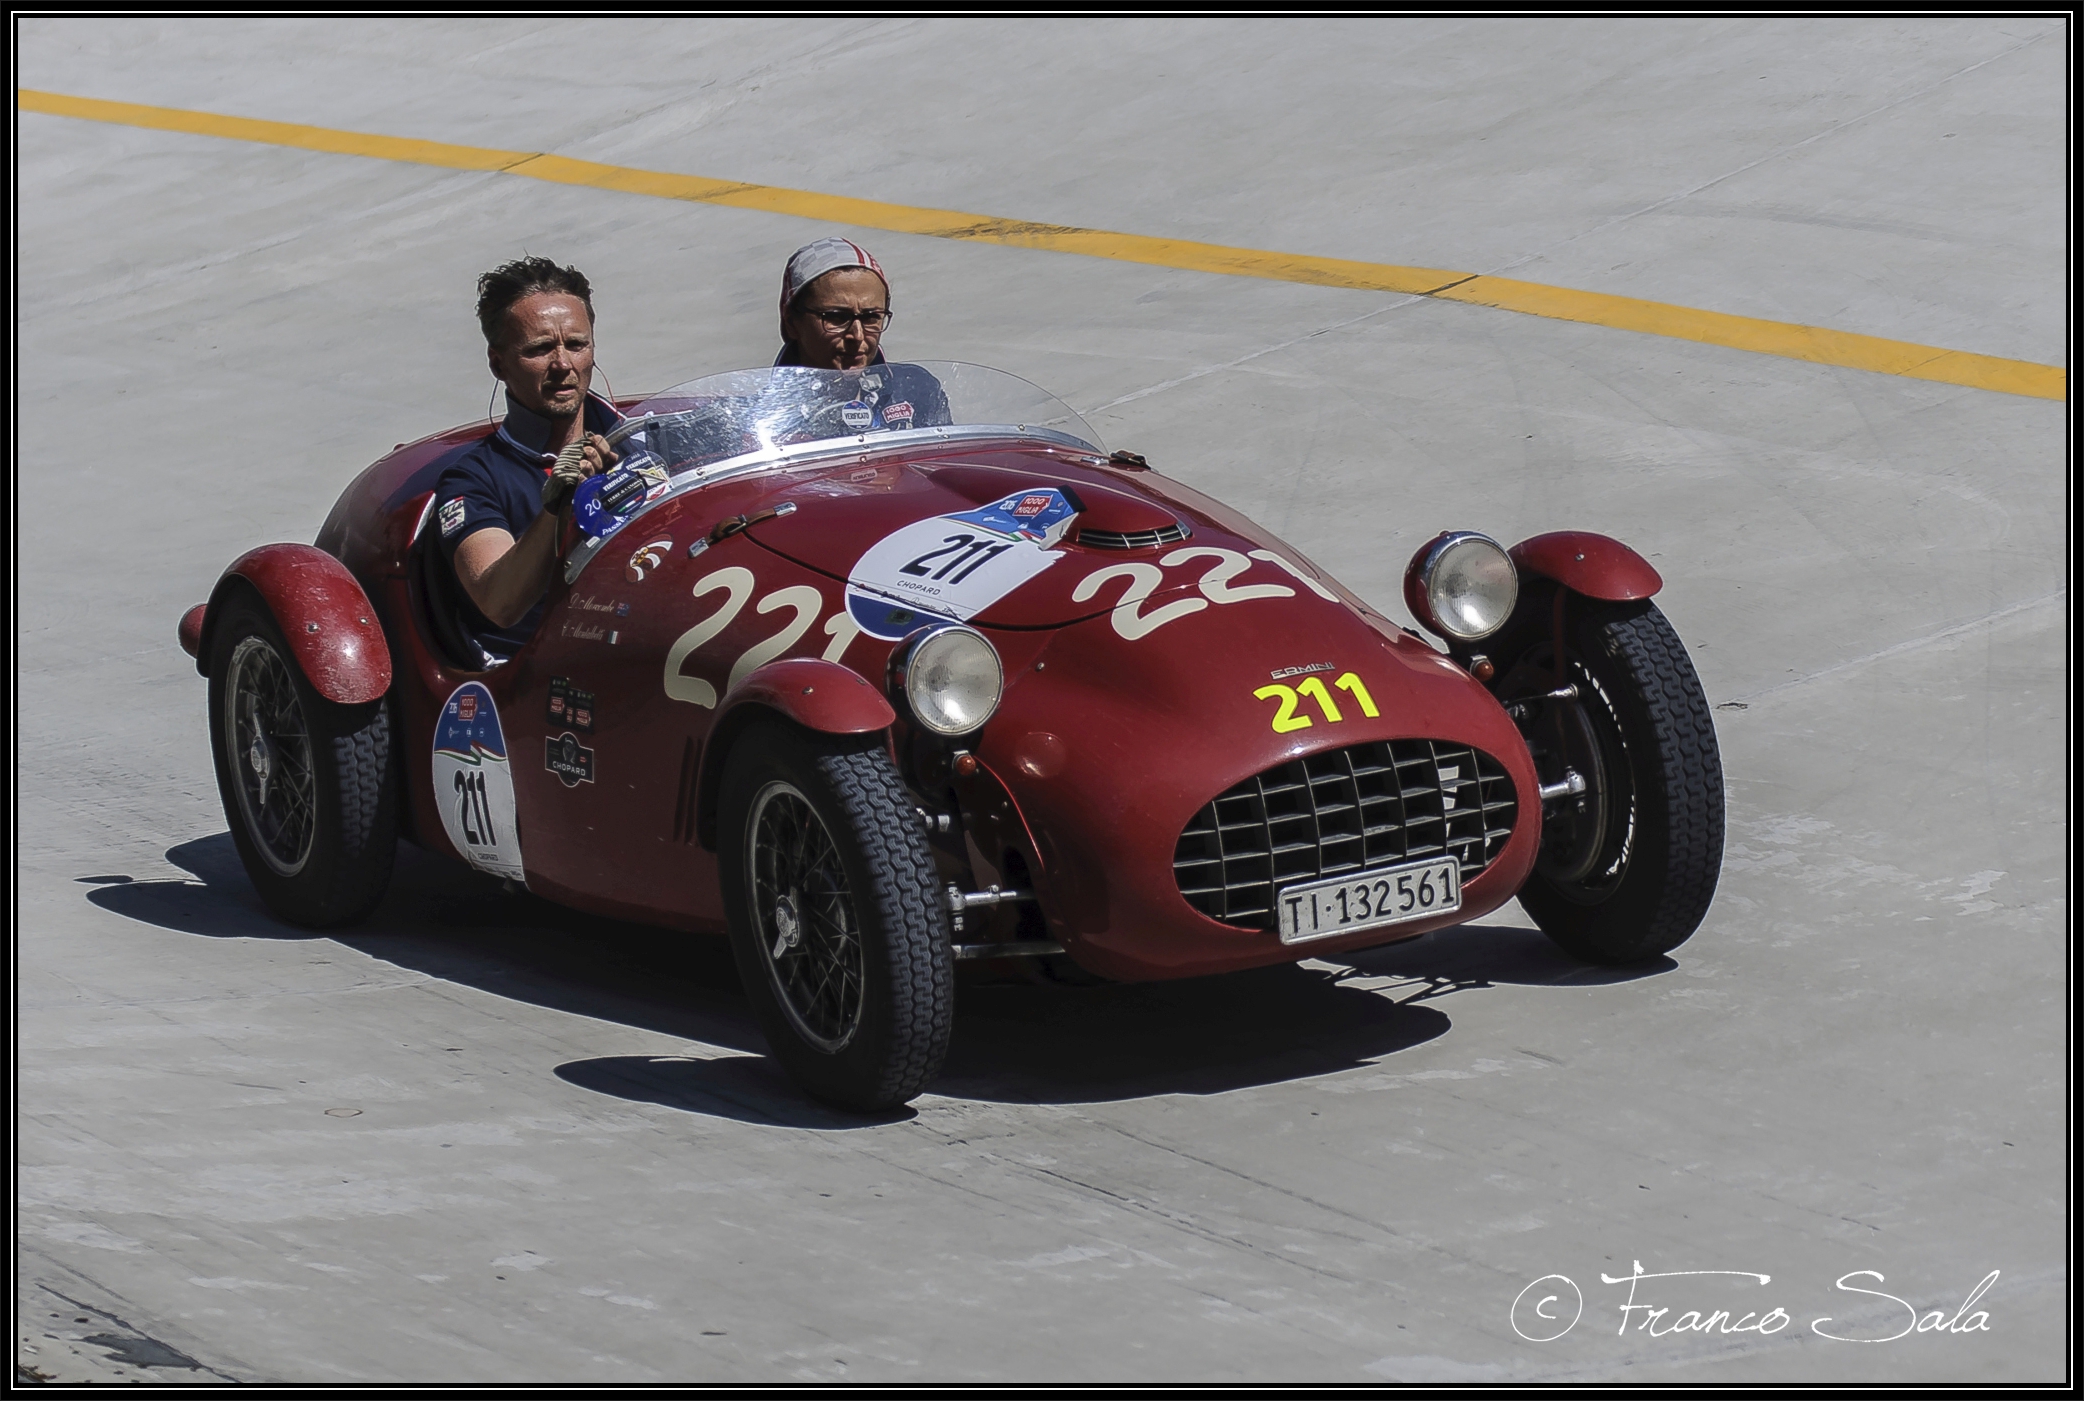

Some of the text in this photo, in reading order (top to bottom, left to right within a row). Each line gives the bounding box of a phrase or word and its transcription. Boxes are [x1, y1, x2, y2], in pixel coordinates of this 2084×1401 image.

[886, 404, 907, 414] 1000
[887, 411, 910, 420] MIGLIA
[625, 455, 652, 471] VERIFICATO
[602, 472, 629, 492] VERIFICATO
[584, 498, 601, 517] 20
[1024, 497, 1046, 505] 1000
[1015, 506, 1040, 514] MIGLIA
[899, 534, 1015, 585] 211
[896, 580, 941, 596] CHOPARD
[1270, 662, 1336, 680] ERMINI
[461, 698, 474, 706] 1000
[1252, 672, 1381, 734] 211
[459, 709, 473, 718] MIGLIA
[552, 760, 586, 777] CHOPARD
[454, 769, 497, 846] 211
